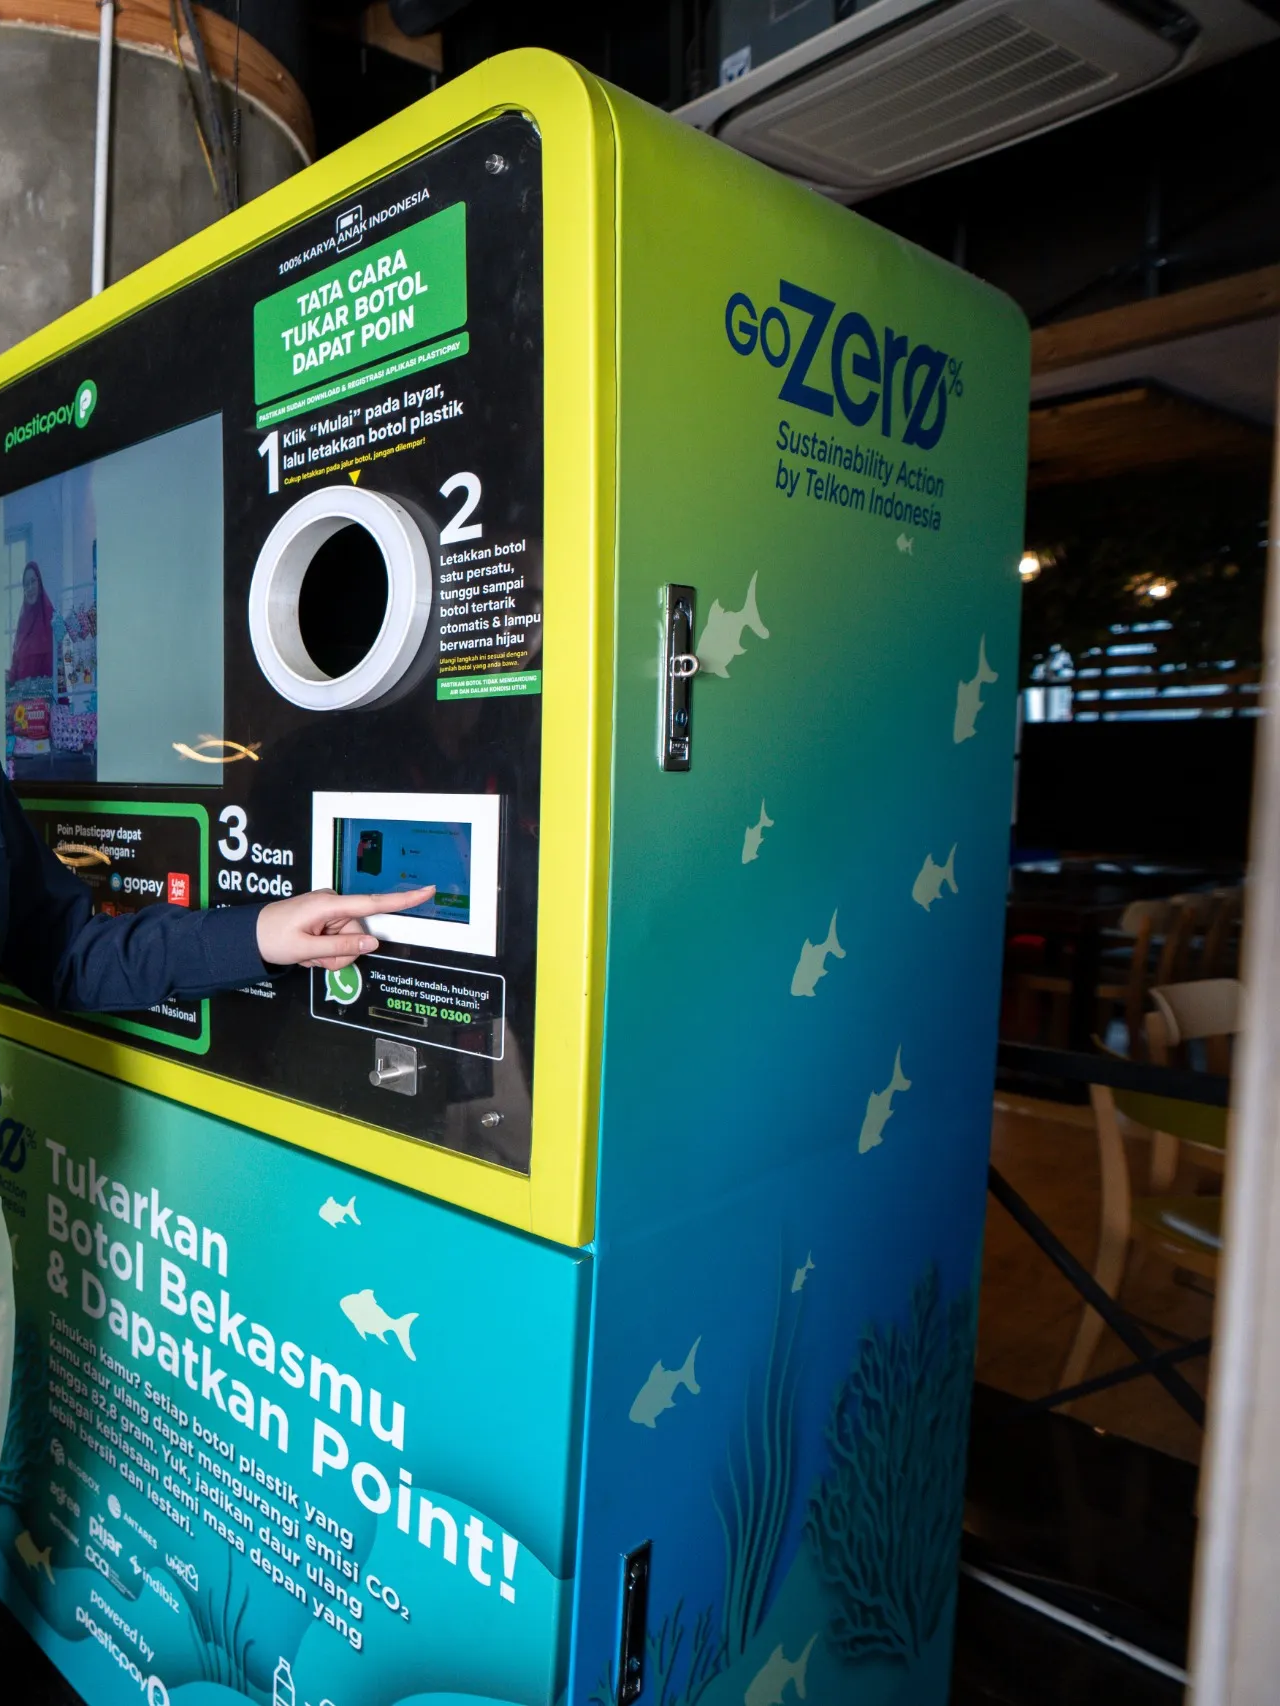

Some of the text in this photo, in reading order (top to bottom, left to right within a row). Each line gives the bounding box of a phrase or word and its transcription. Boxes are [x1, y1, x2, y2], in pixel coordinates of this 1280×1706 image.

[278, 188, 430, 275] 100% KARYA ANAK INDONESIA
[281, 271, 428, 352] TUKAR BOTOL
[297, 248, 408, 317] TATA CARA
[292, 304, 415, 376] DAPAT POIN
[259, 341, 461, 423] PASTIKAN SUDAH DOWNLOAD & REGISTRASI APLIKASI PLASTICPAY
[4, 401, 75, 453] plasticpay
[283, 428, 307, 449] Klik
[365, 400, 400, 425] pada
[403, 383, 445, 409] layar,
[283, 400, 464, 471] lalu letakkan botol plastik
[257, 430, 280, 495] 1
[302, 467, 326, 481] letakkan
[325, 463, 341, 476] pada
[373, 447, 395, 462] jangan
[395, 436, 426, 455] dilempar!
[775, 419, 945, 499] Sustainability Action
[439, 471, 483, 546] 2
[775, 458, 942, 532] by Telkom Indonesia
[440, 539, 526, 567] Letakkan botol
[440, 563, 515, 584] satu persatu,
[440, 575, 524, 603] tunggu sampai
[440, 596, 516, 618] botol tertarik
[440, 611, 541, 636] otomatis & lampu
[440, 631, 525, 652] berwarna hijau
[472, 662, 487, 671] yang
[487, 661, 501, 669] anda
[483, 677, 498, 686] TIDAK
[506, 650, 528, 660] dengan
[57, 823, 142, 843] Poin Plasticpay dapat
[98, 842, 130, 860] dengan
[217, 804, 294, 866] 3 Scan
[123, 876, 165, 897] gopay
[217, 869, 293, 897] QR Code
[161, 1004, 197, 1023] Nasional
[370, 970, 490, 1001] Jika terjadi kendala, hubungi
[380, 984, 480, 1010] Customer Support kami:
[386, 997, 472, 1024] 0812 1312 0300
[45, 1138, 229, 1277] Tukarkan
[45, 1193, 406, 1452] Botol Bekasmu
[46, 1249, 520, 1604] & Dapatkan Point!
[50, 1310, 355, 1551] Tahukah kamu? Setiap botol plastik yang
[49, 1398, 195, 1537] lebih bersih dan lestari.
[50, 1333, 80, 1368] kamu
[83, 1361, 111, 1391] daur
[113, 1384, 150, 1425] ulang
[153, 1416, 195, 1458] dapat
[198, 1451, 300, 1540] mengurangi
[305, 1531, 359, 1583] emisi
[50, 1355, 364, 1620] hingga 82,8 gram. Yuk, jadikan daur ulang
[49, 1380, 364, 1651] sebagai kebiasaan demi masa depan yang
[122, 1512, 158, 1550] ANTARES
[142, 1566, 180, 1614] indibiz
[75, 1606, 148, 1692] plasticpay
[90, 1588, 155, 1663] powered by
